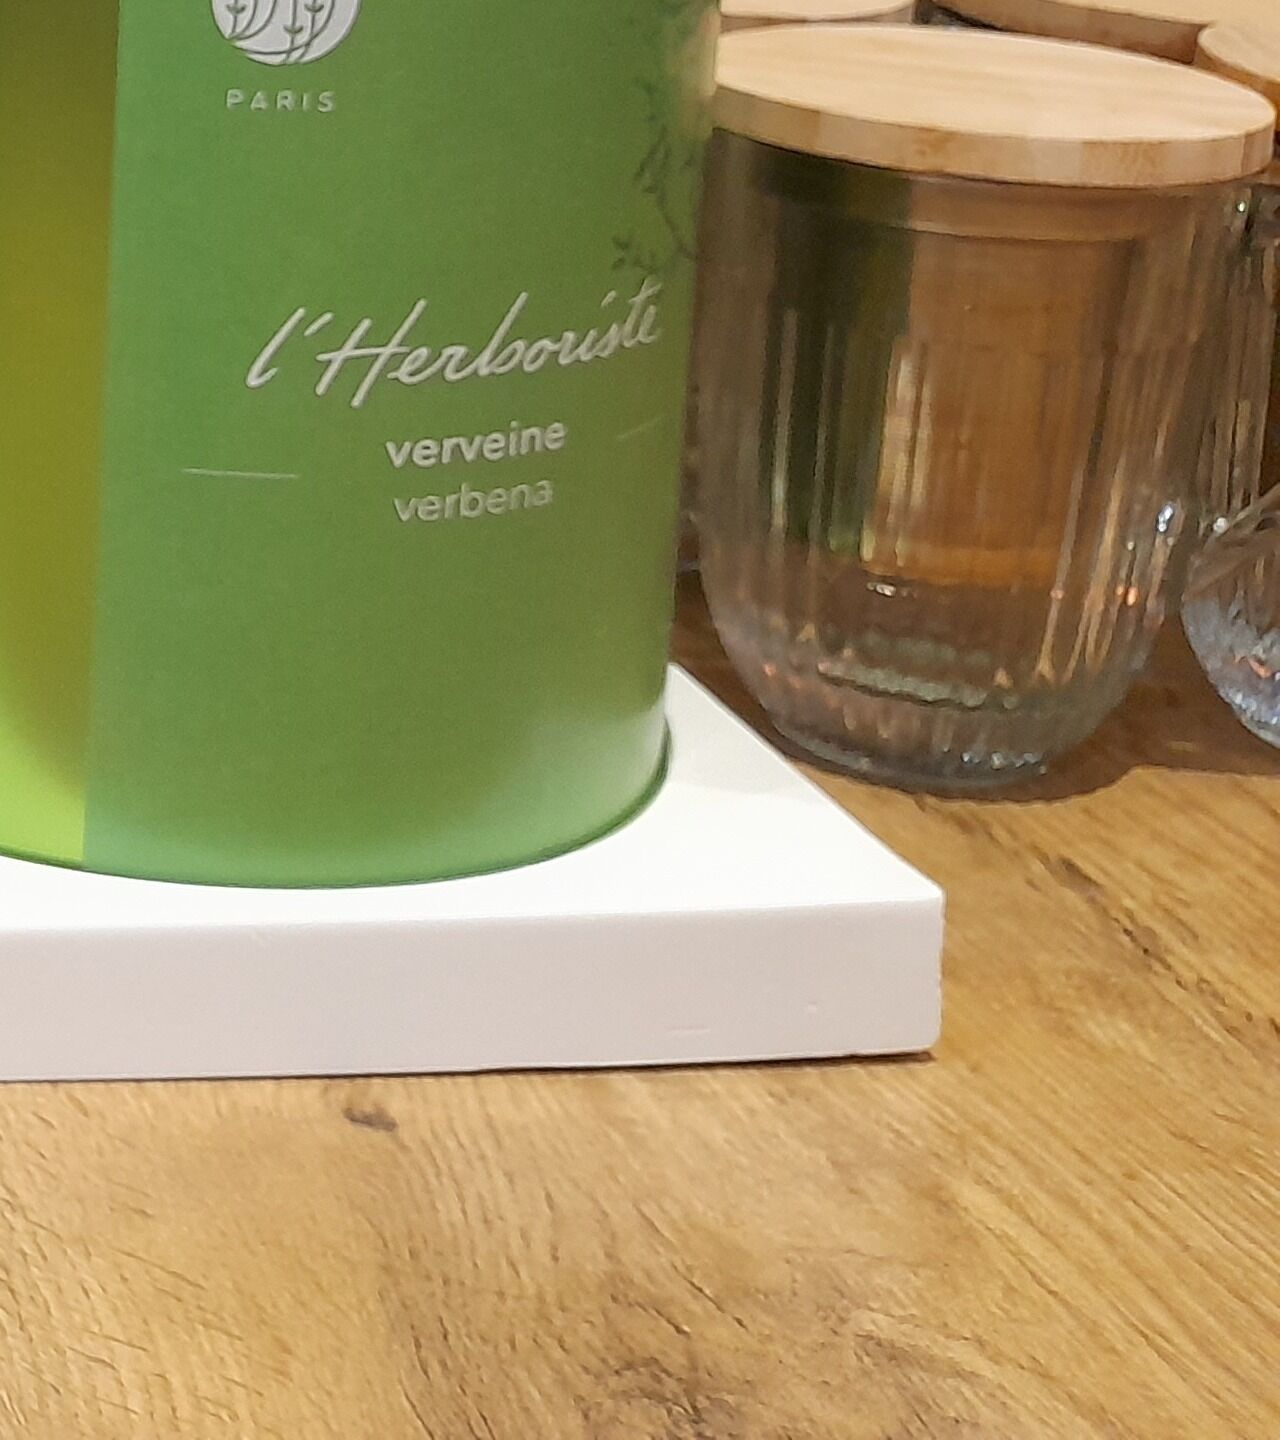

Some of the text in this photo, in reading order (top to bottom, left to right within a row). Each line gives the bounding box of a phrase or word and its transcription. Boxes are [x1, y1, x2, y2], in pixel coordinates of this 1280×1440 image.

[226, 89, 335, 112] PARIS
[386, 420, 568, 468] verveine
[393, 479, 554, 522] verbena
